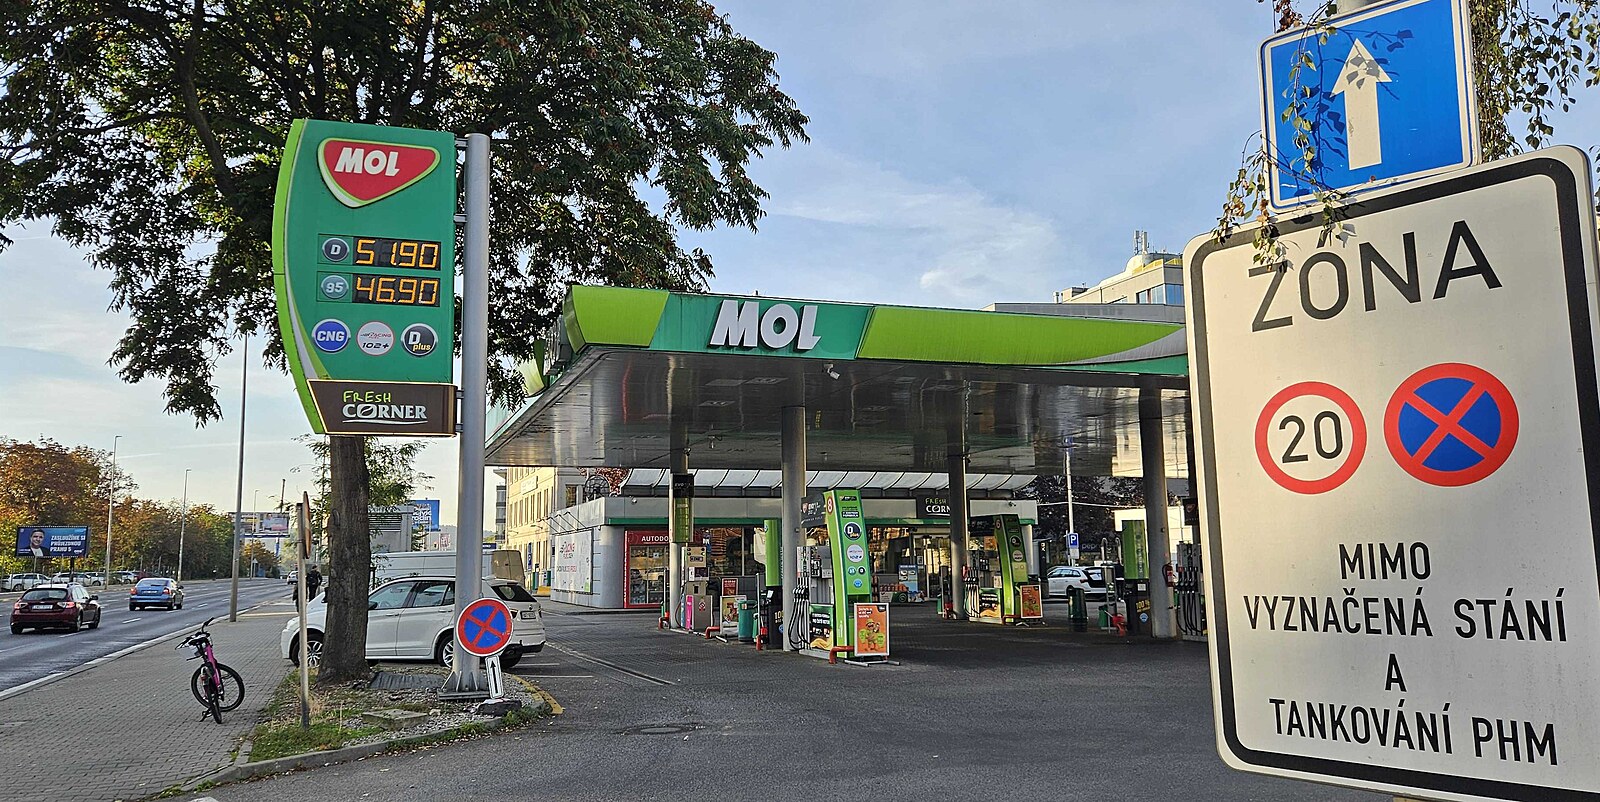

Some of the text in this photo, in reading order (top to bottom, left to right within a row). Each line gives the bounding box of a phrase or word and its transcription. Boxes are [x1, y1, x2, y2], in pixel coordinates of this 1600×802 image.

[334, 147, 400, 177] MOL
[330, 244, 341, 255] D
[326, 282, 343, 294] 95
[710, 299, 821, 350] MOL
[316, 330, 345, 342] CNG
[408, 331, 421, 345] D
[412, 342, 432, 352] plus
[343, 390, 392, 403] FRESH
[342, 403, 427, 419] CORNER
[1278, 410, 1343, 464] 20
[827, 498, 833, 513] 8
[925, 497, 947, 505] FRESH
[1070, 535, 1077, 543] P
[1338, 541, 1432, 580] MIMO
[1243, 586, 1567, 642] VYZNAČENÁ STÁNÍ
[1385, 653, 1407, 692] A
[1268, 698, 1558, 766] TANKOVÁNÍ PHM
